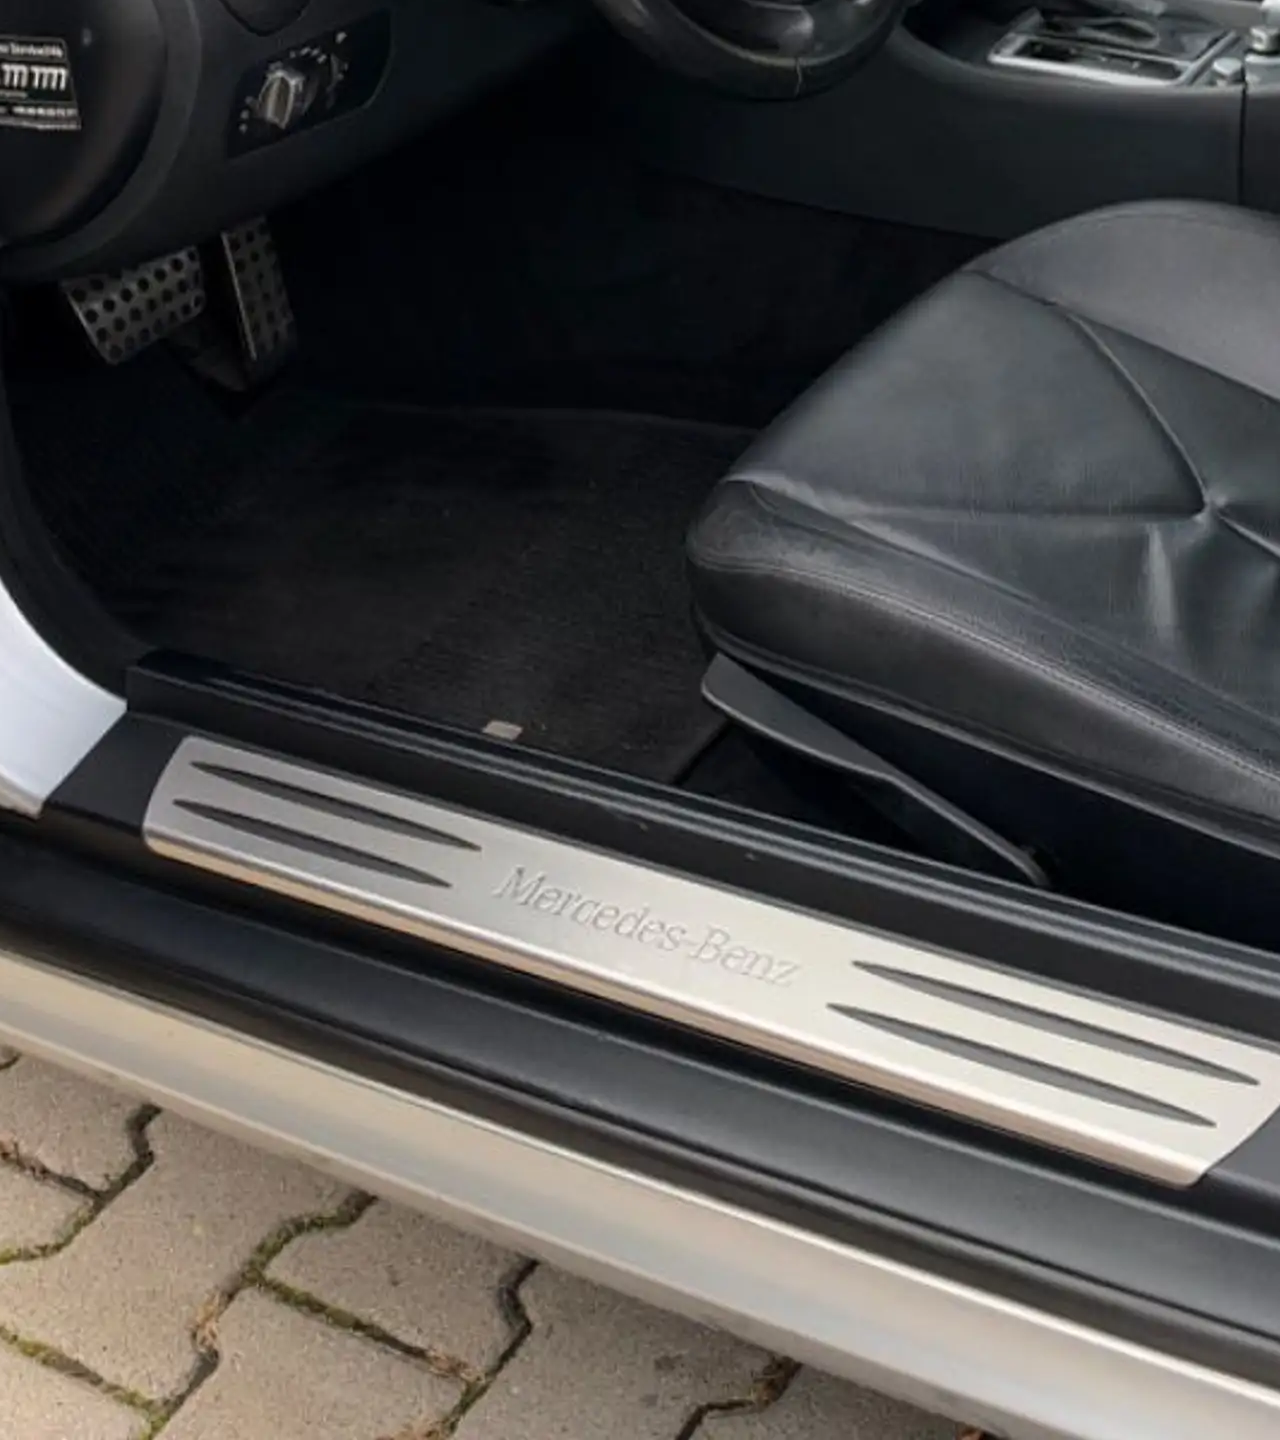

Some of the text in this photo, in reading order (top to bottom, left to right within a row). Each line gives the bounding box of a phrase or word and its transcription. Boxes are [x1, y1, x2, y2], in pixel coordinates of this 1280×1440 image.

[1, 62, 29, 89] 777
[30, 64, 69, 92] 7777
[490, 864, 802, 988] Mercedes-Benz
